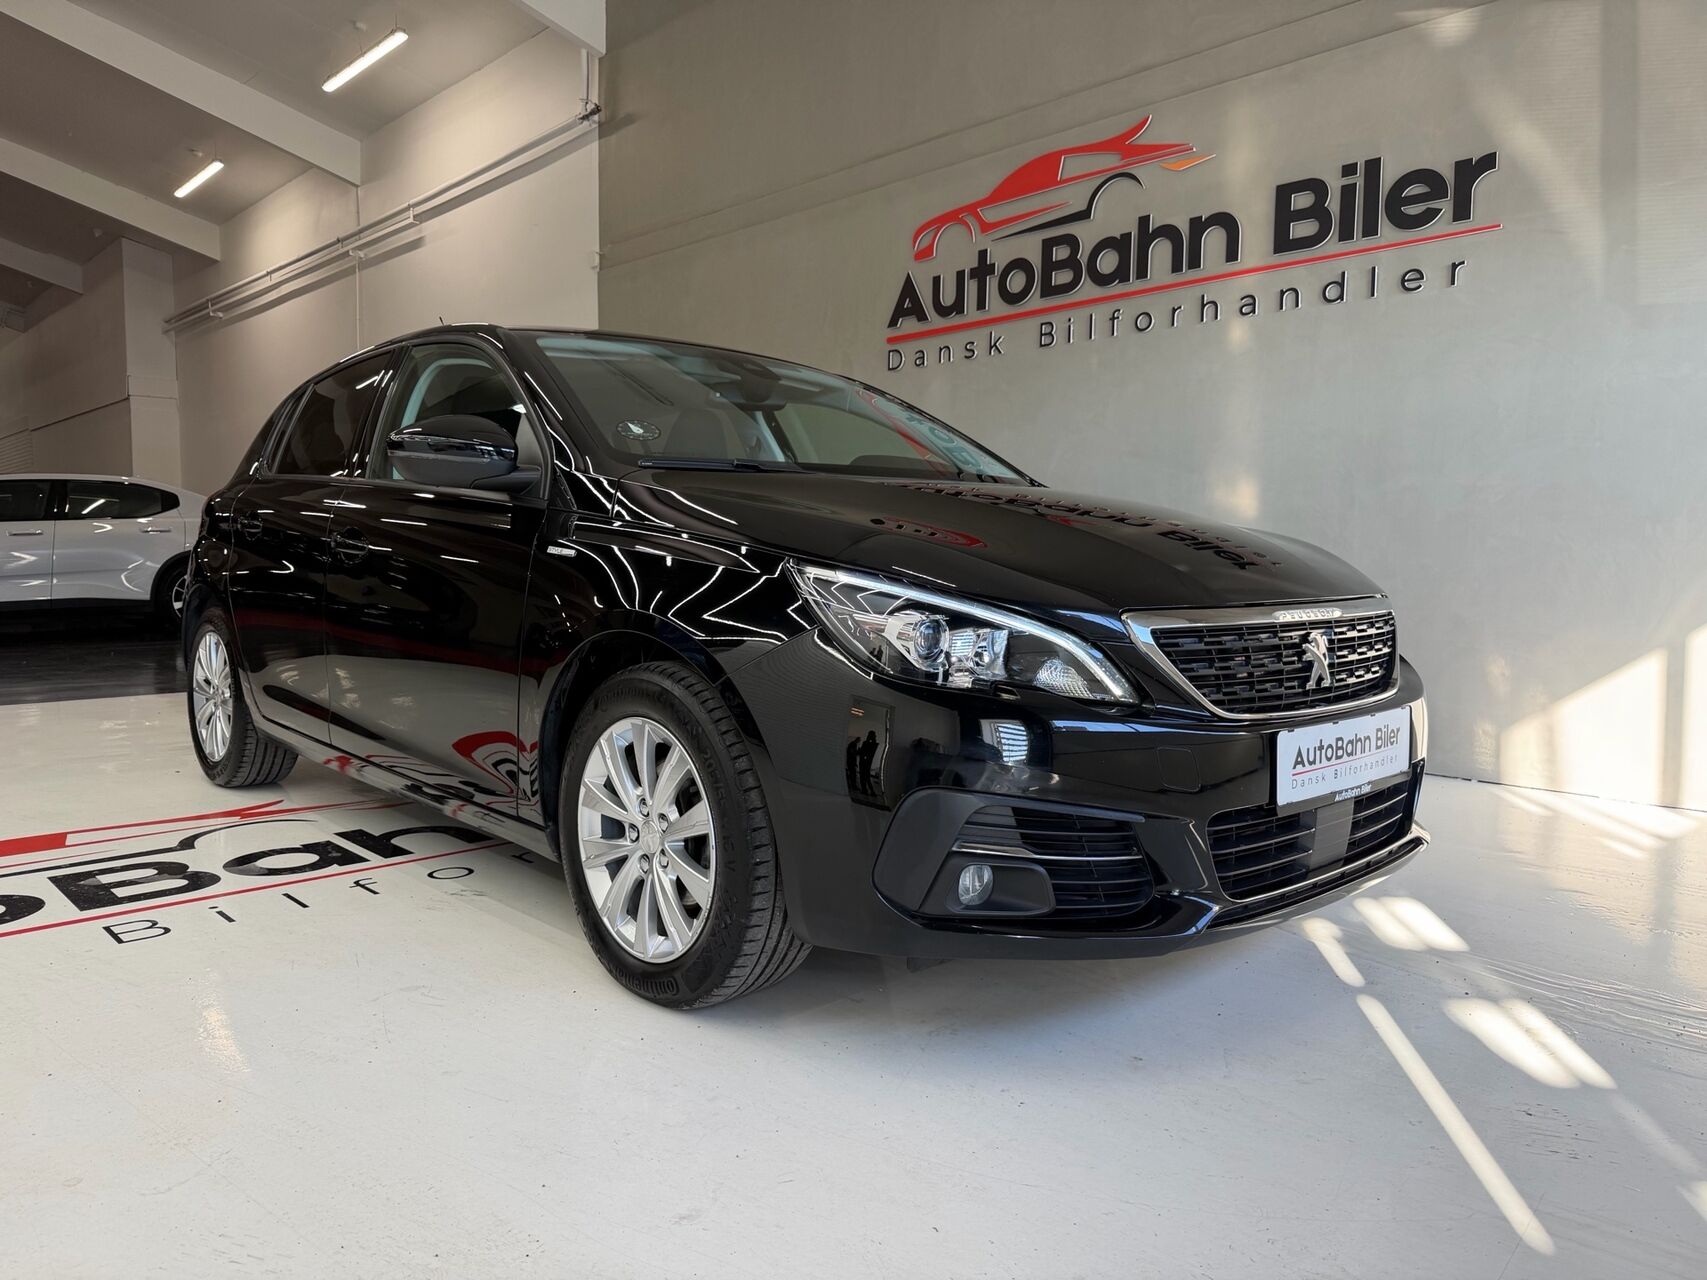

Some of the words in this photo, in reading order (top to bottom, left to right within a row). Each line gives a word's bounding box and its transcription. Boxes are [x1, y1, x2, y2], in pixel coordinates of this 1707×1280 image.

[887, 211, 1241, 329] AutoBahn
[1273, 151, 1500, 256] Biler
[887, 330, 1006, 372] Dansk
[1038, 257, 1468, 349] Bilforhandler
[1280, 609, 1334, 621] PEUGEOT
[1291, 732, 1373, 770] AutoBahn
[1375, 725, 1401, 750] Biler
[1291, 773, 1327, 790] Dansk
[1333, 754, 1399, 779] Bilforhandler
[1334, 786, 1361, 802] AutoBahn
[1360, 783, 1372, 796] Biler
